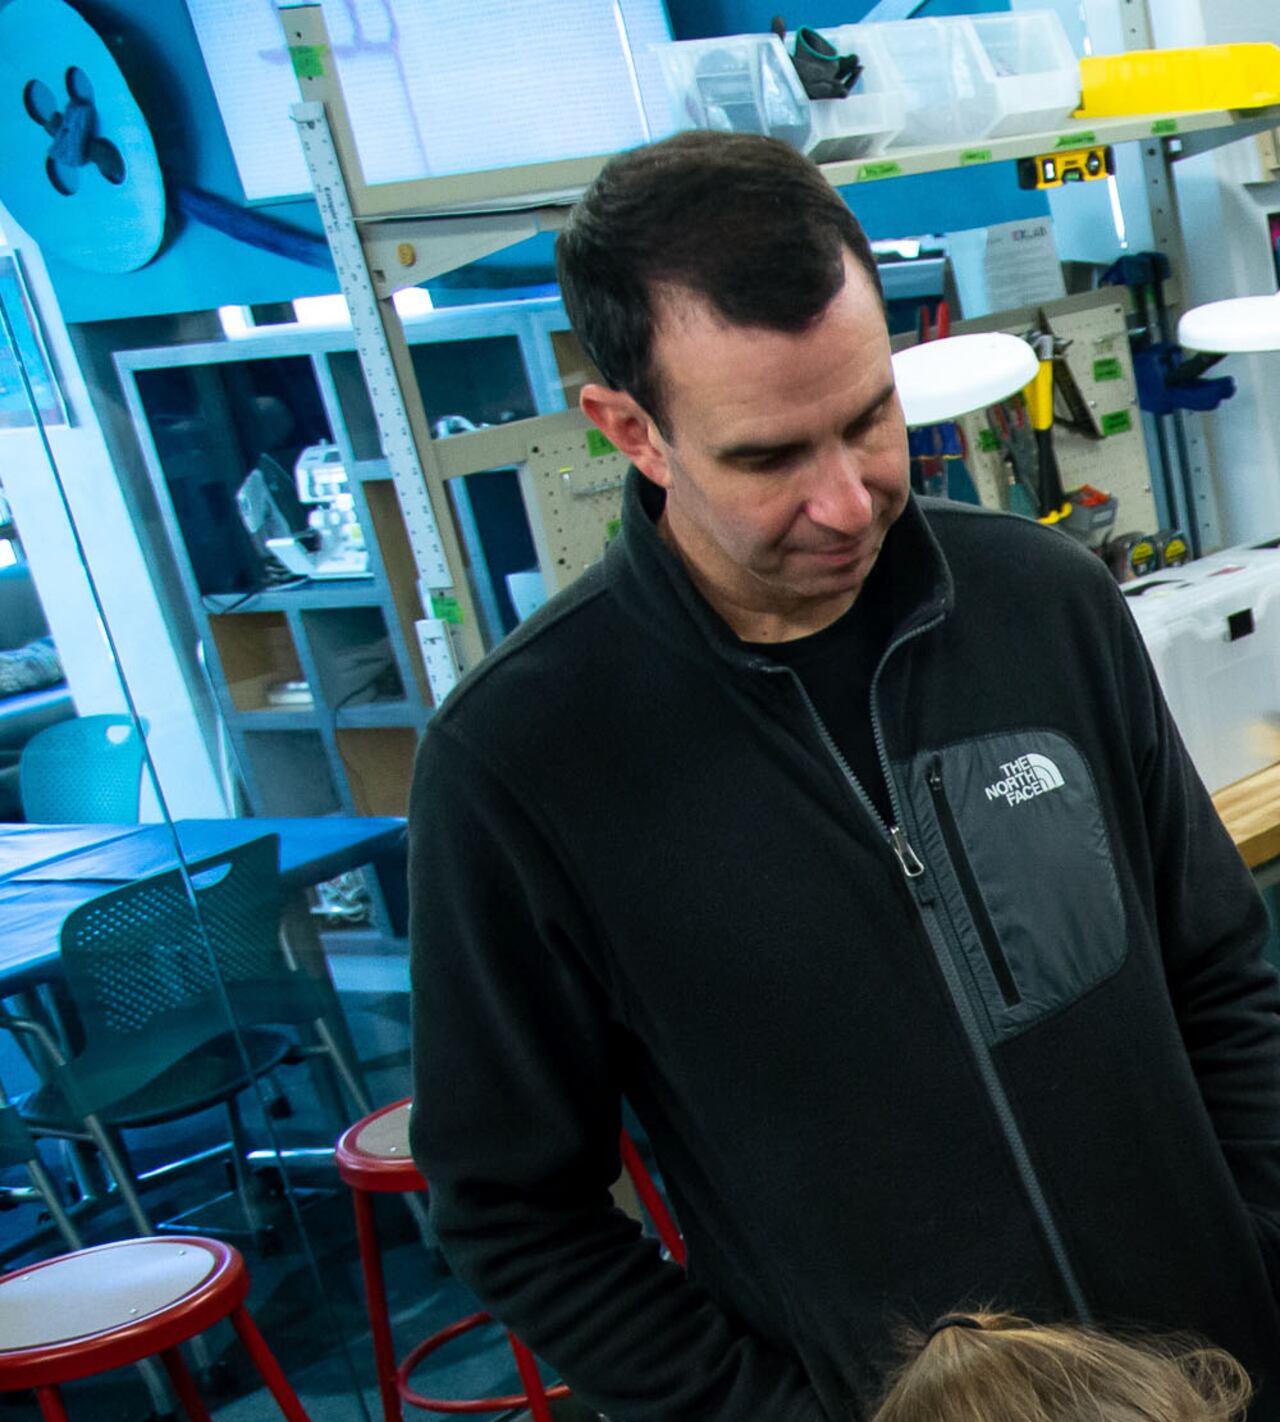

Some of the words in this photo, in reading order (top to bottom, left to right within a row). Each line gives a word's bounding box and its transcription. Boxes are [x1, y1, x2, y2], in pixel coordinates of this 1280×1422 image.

[1000, 756, 1031, 778] THE
[985, 768, 1038, 801] NORTH
[1006, 781, 1043, 808] FACE
